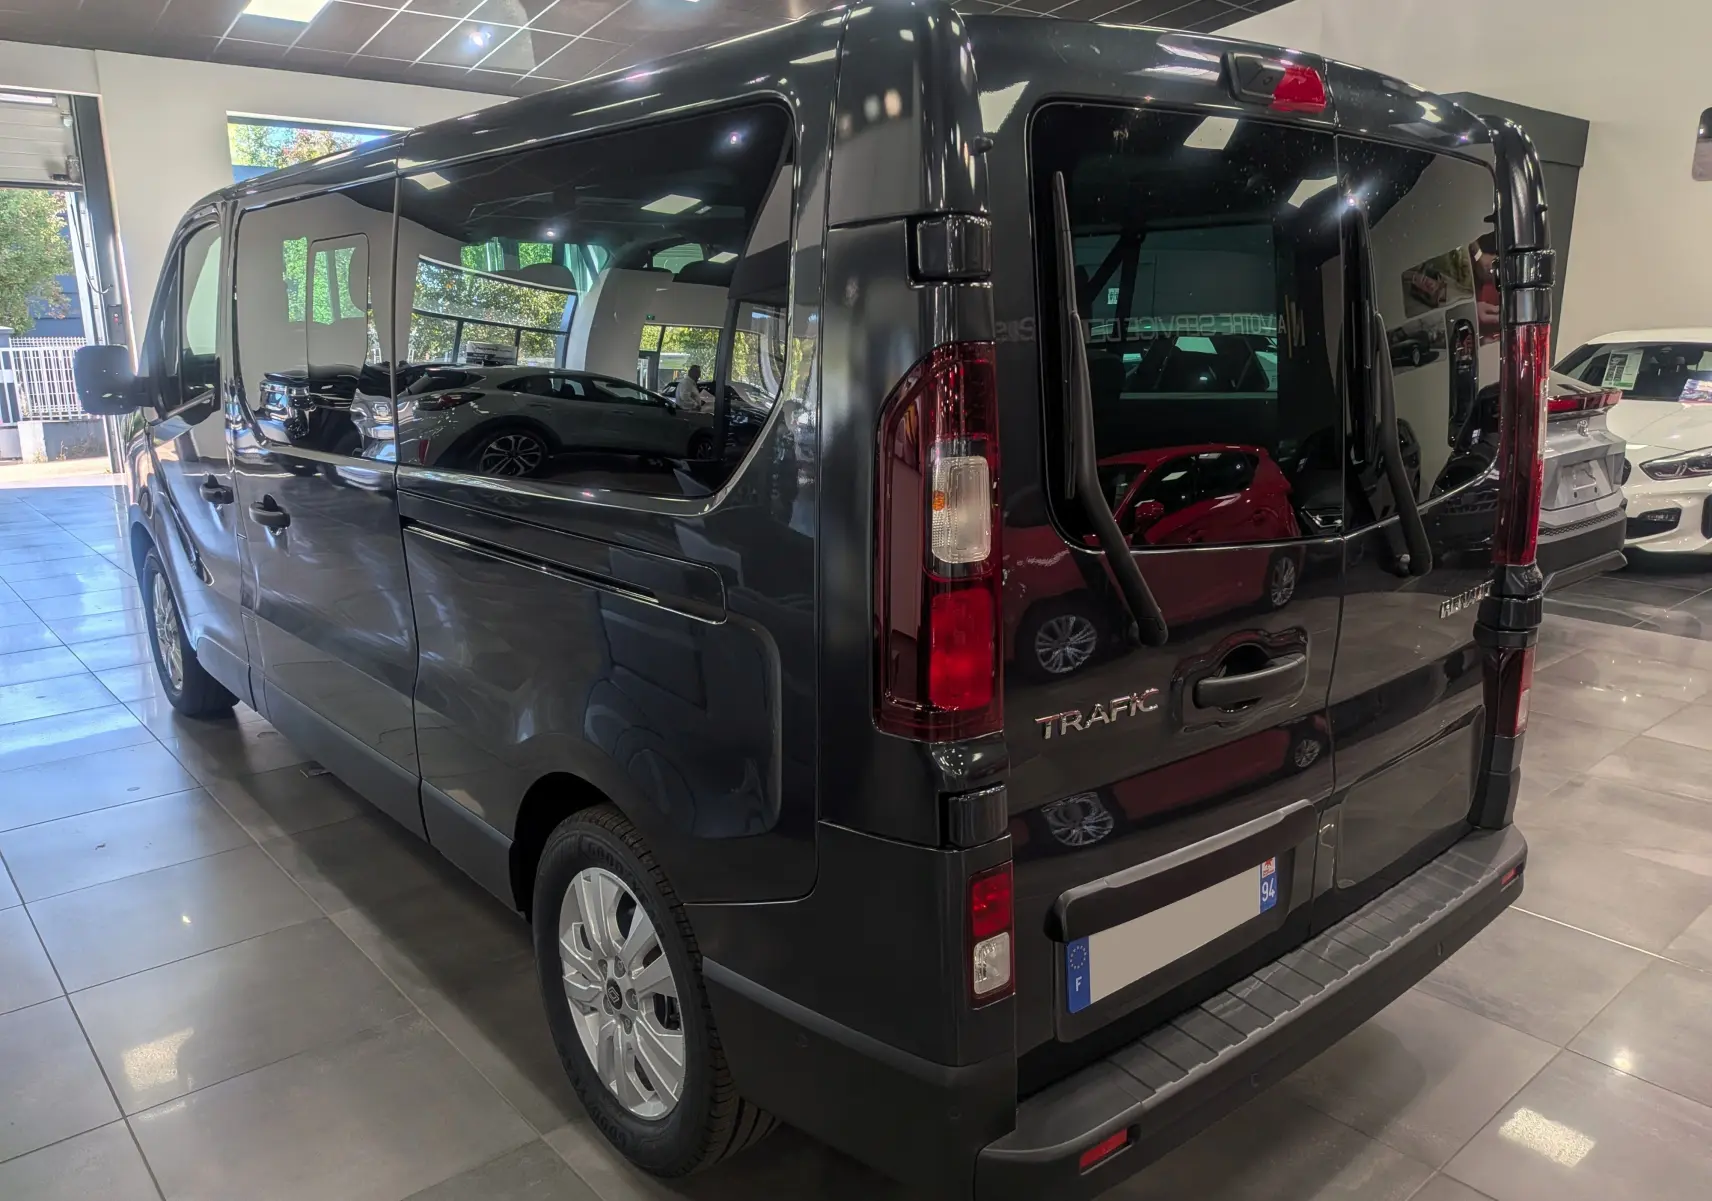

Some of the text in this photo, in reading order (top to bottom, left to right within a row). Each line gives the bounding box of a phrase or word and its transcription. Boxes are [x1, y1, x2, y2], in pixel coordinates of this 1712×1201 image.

[1034, 688, 1159, 740] TRAFIC
[1262, 877, 1275, 902] 94
[1075, 975, 1083, 992] F
